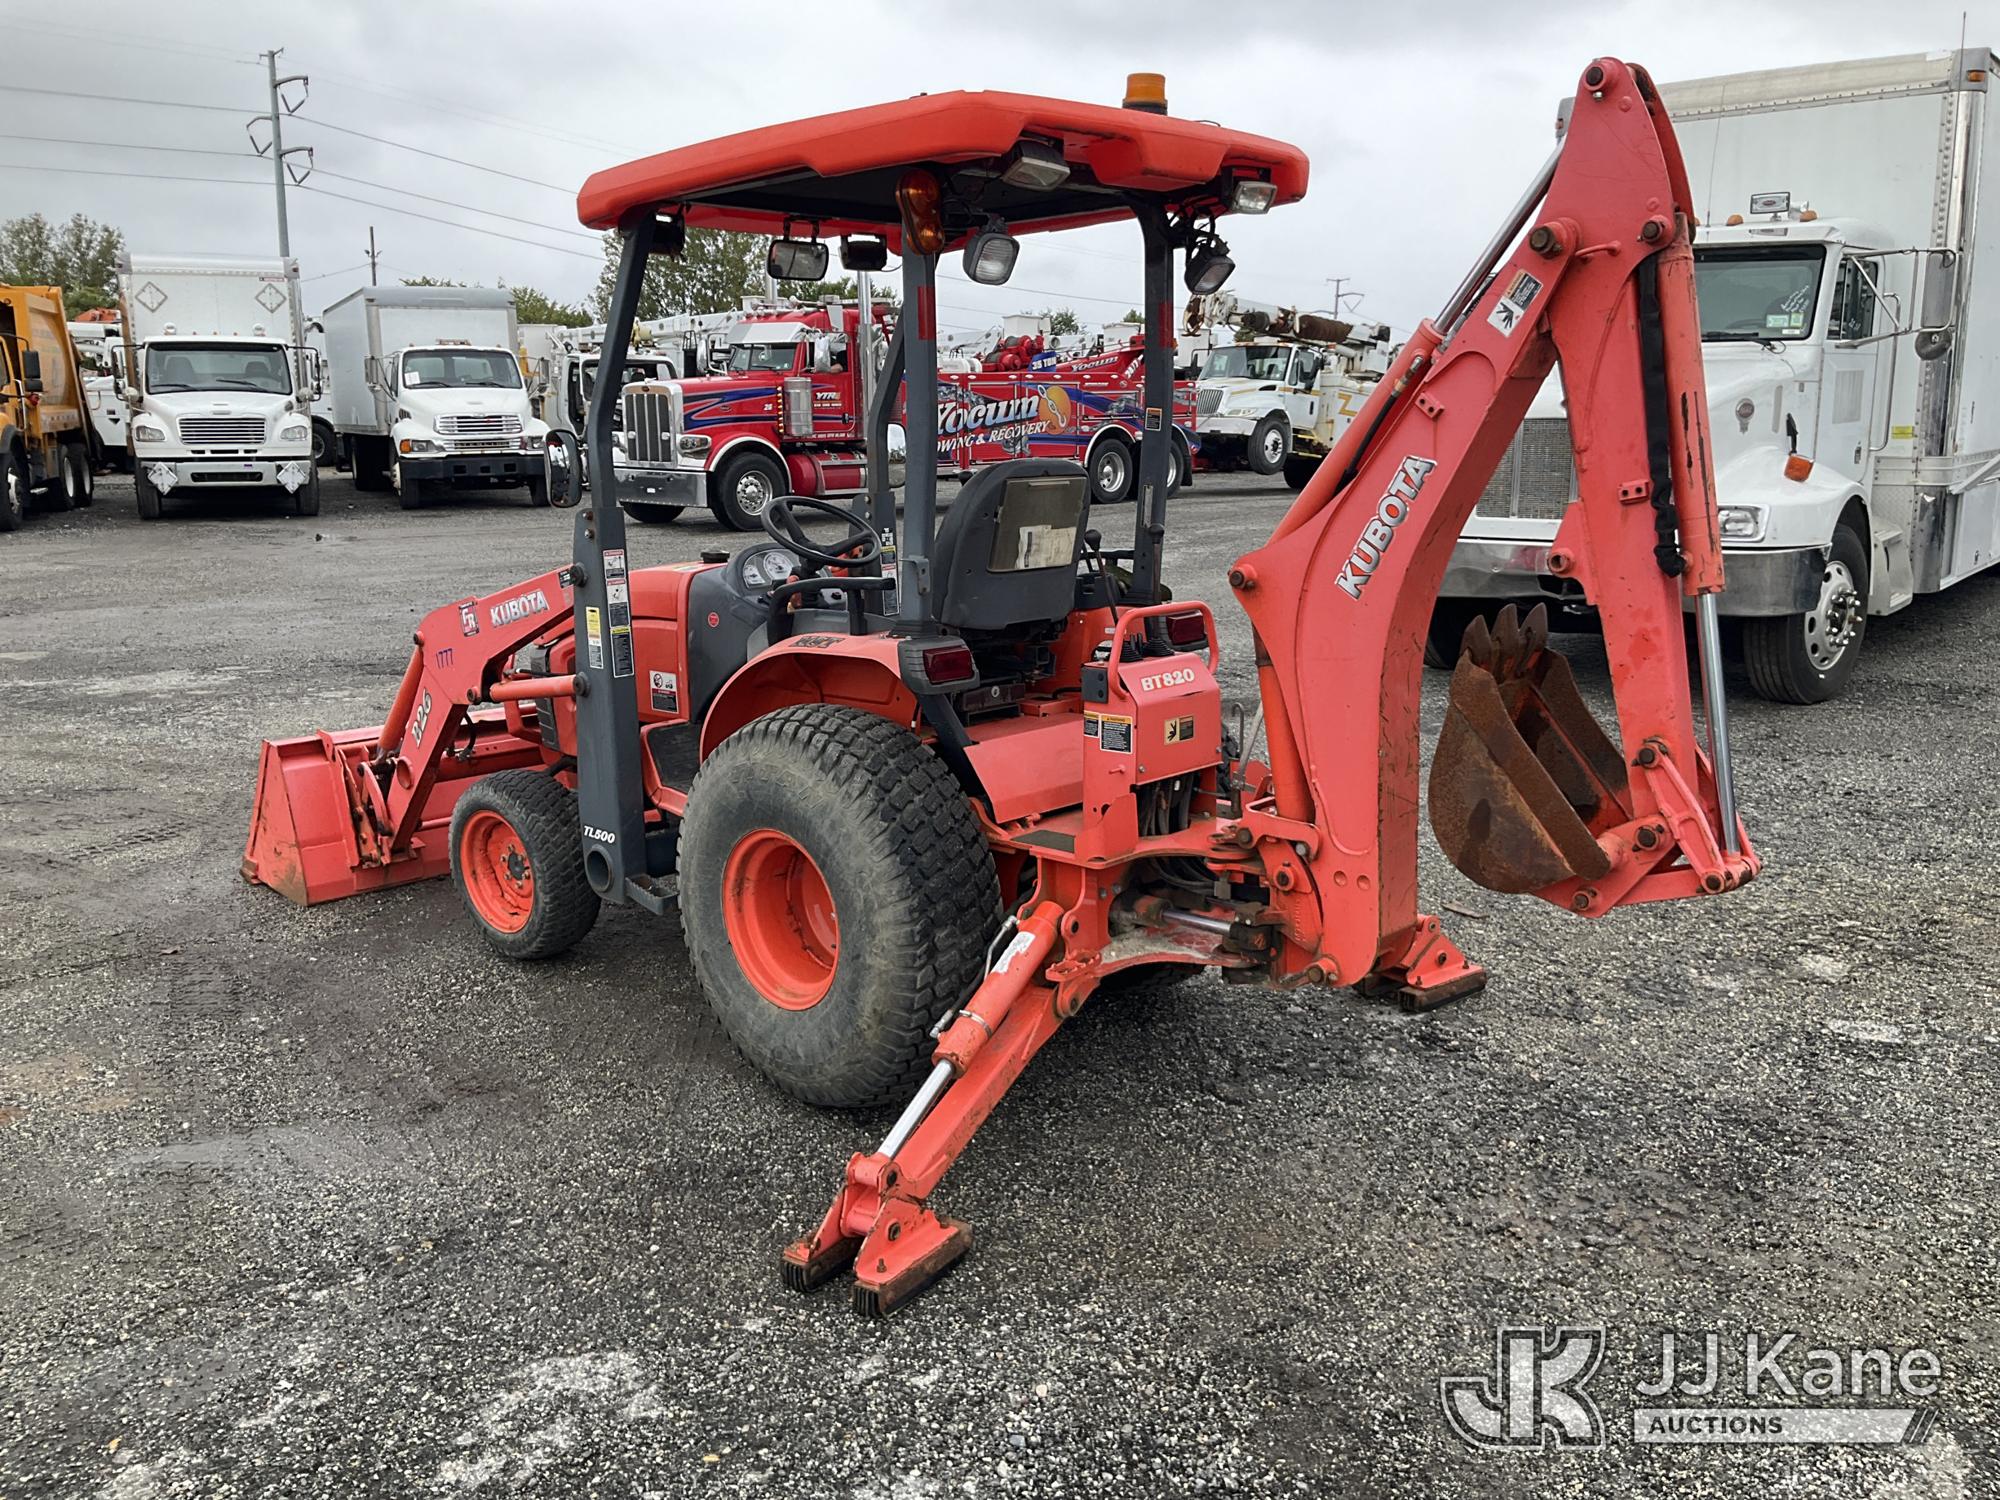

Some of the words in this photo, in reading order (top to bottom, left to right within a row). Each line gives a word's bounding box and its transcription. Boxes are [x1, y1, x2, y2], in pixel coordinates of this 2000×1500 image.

[975, 433, 986, 445] &
[988, 419, 1051, 443] RECOVERY
[1335, 455, 1437, 600] KUBOTA
[490, 589, 548, 628] KUBOTA
[1140, 668, 1196, 692] BT820
[583, 825, 616, 844] TL500
